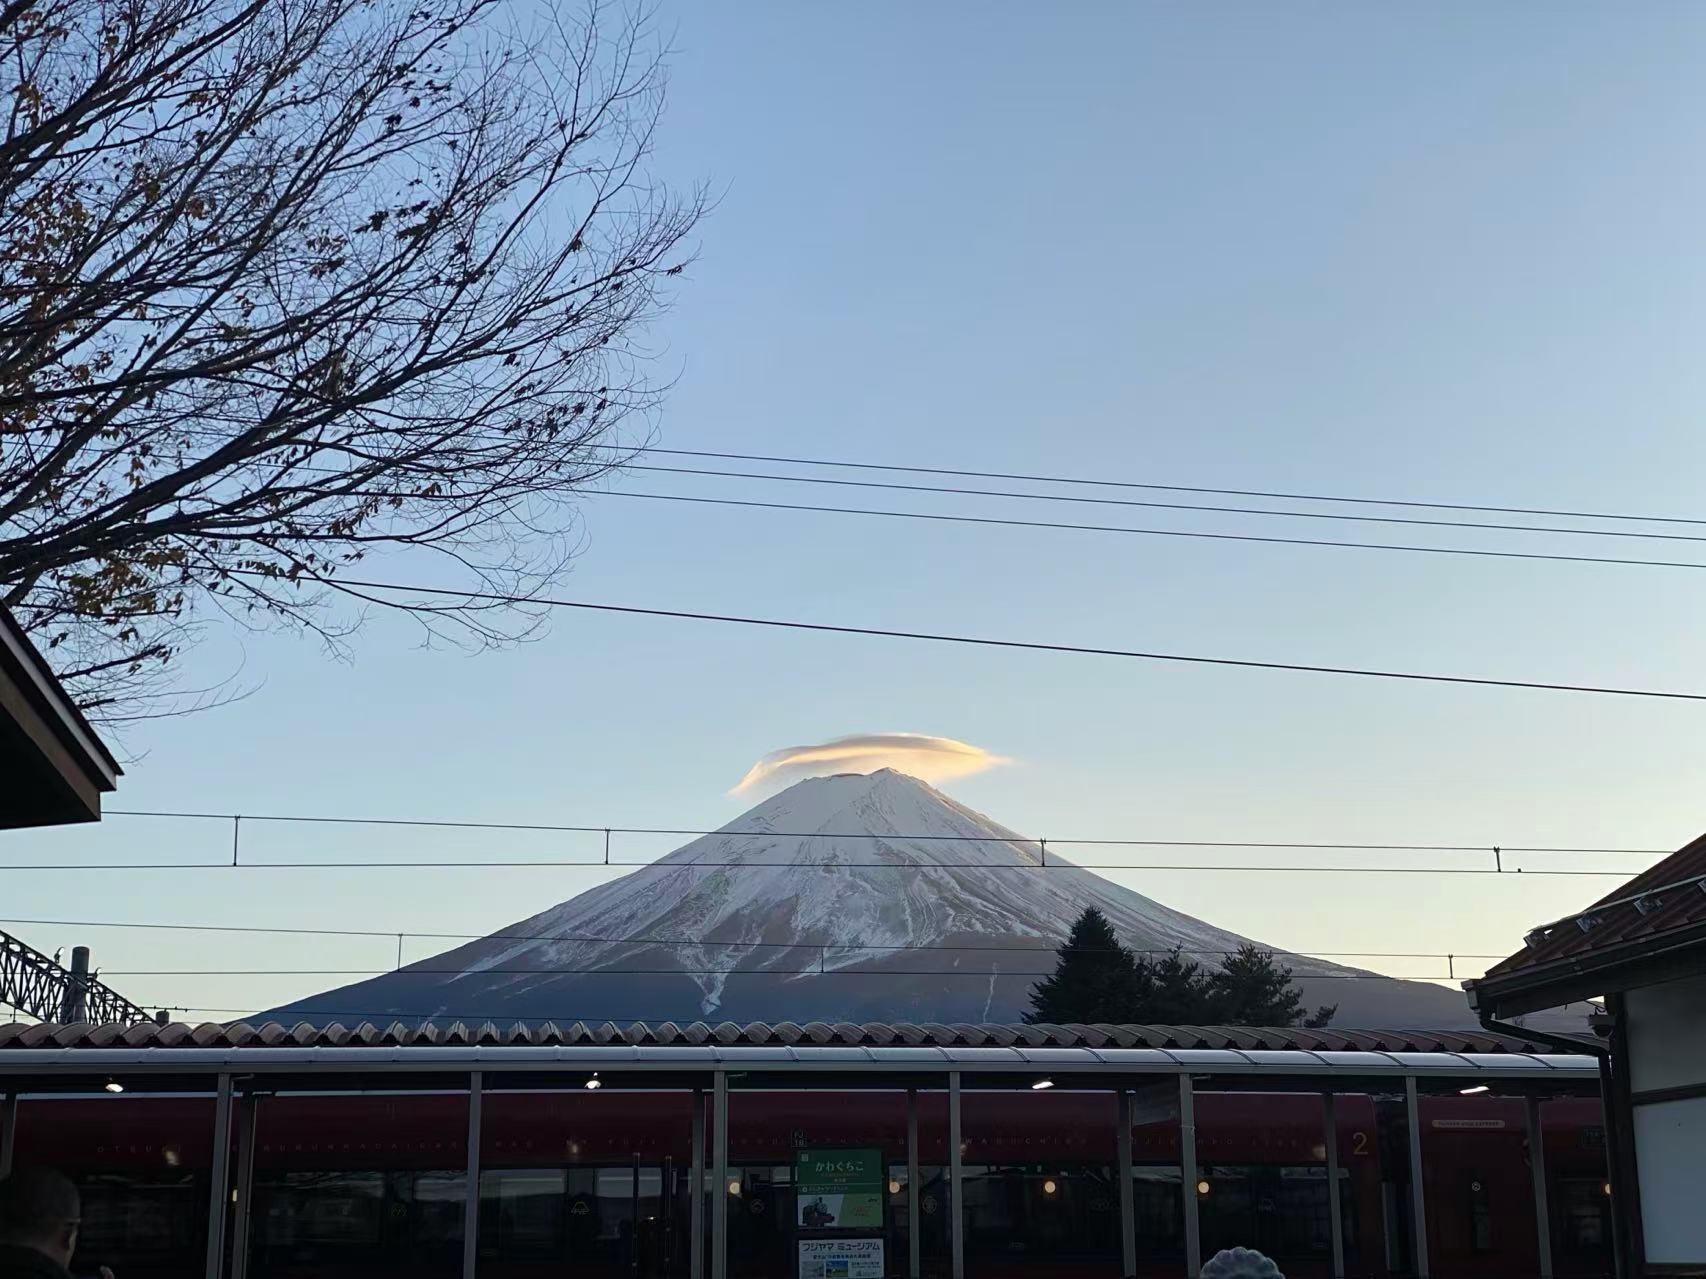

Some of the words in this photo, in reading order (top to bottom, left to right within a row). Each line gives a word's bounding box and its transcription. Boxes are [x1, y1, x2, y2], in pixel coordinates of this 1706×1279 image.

[1353, 1132, 1368, 1155] 2
[802, 1242, 834, 1252] フジヤマ
[837, 1242, 881, 1251] ミュージアム
